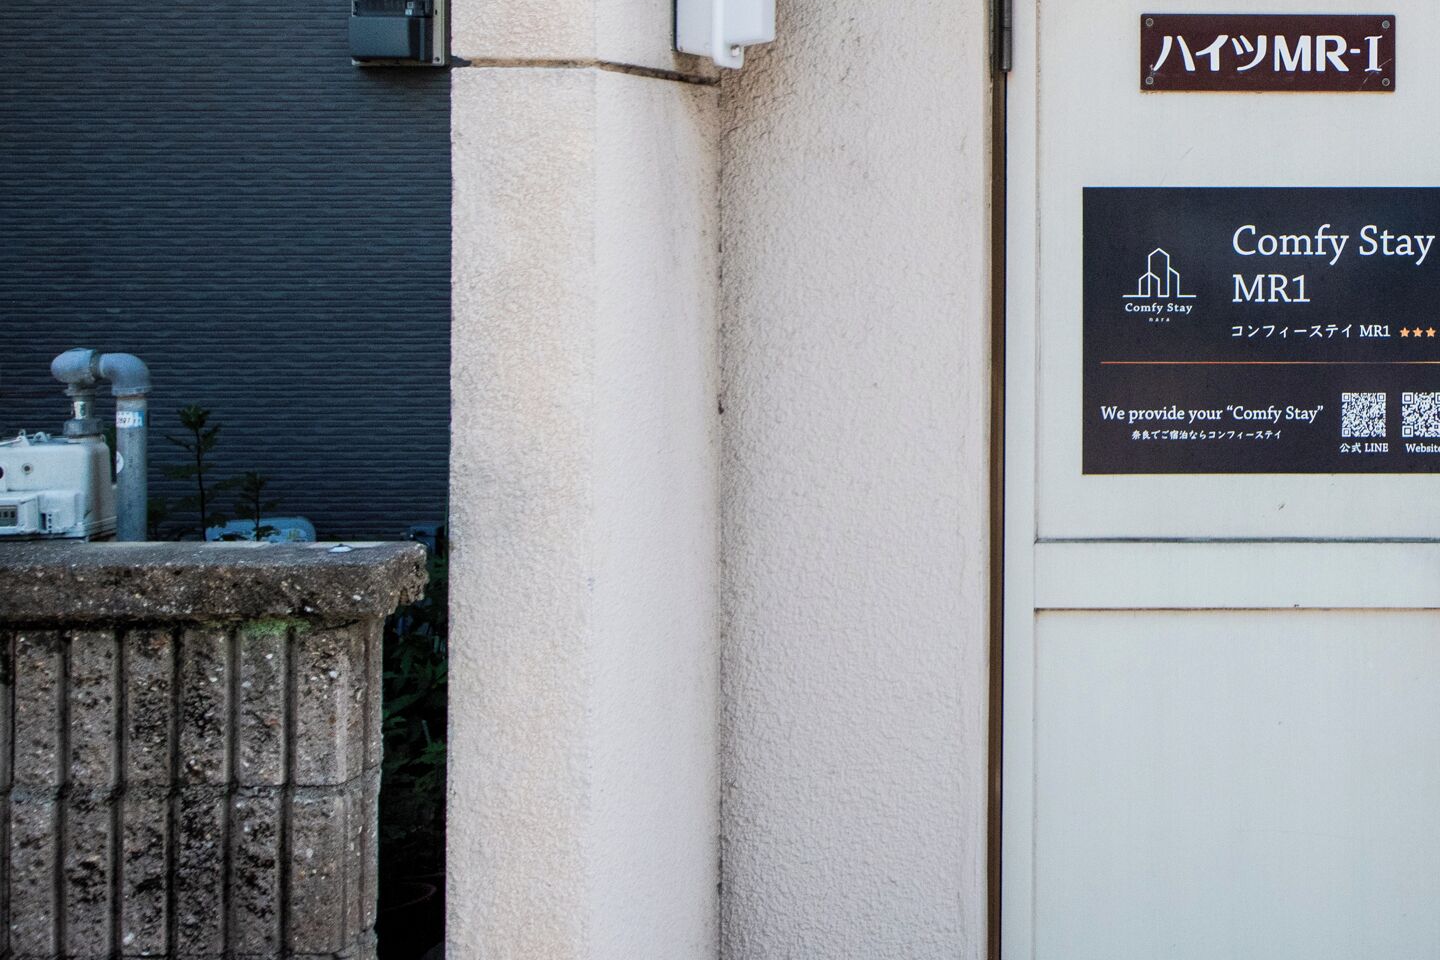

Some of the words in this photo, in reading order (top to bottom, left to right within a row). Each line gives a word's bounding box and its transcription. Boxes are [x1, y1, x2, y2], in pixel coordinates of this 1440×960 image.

[1232, 223, 1350, 266] Comfy
[1358, 224, 1436, 266] Stay
[1232, 273, 1311, 303] MR1
[1124, 302, 1164, 315] Comfy
[1166, 302, 1193, 315] Stay
[1231, 323, 1353, 339] コンフィーステイ
[1359, 324, 1391, 338] MR1
[1100, 405, 1126, 420] We
[1128, 405, 1185, 424] provide
[1188, 409, 1224, 425] your
[1339, 442, 1362, 454] 公式
[1364, 442, 1389, 453] LINE
